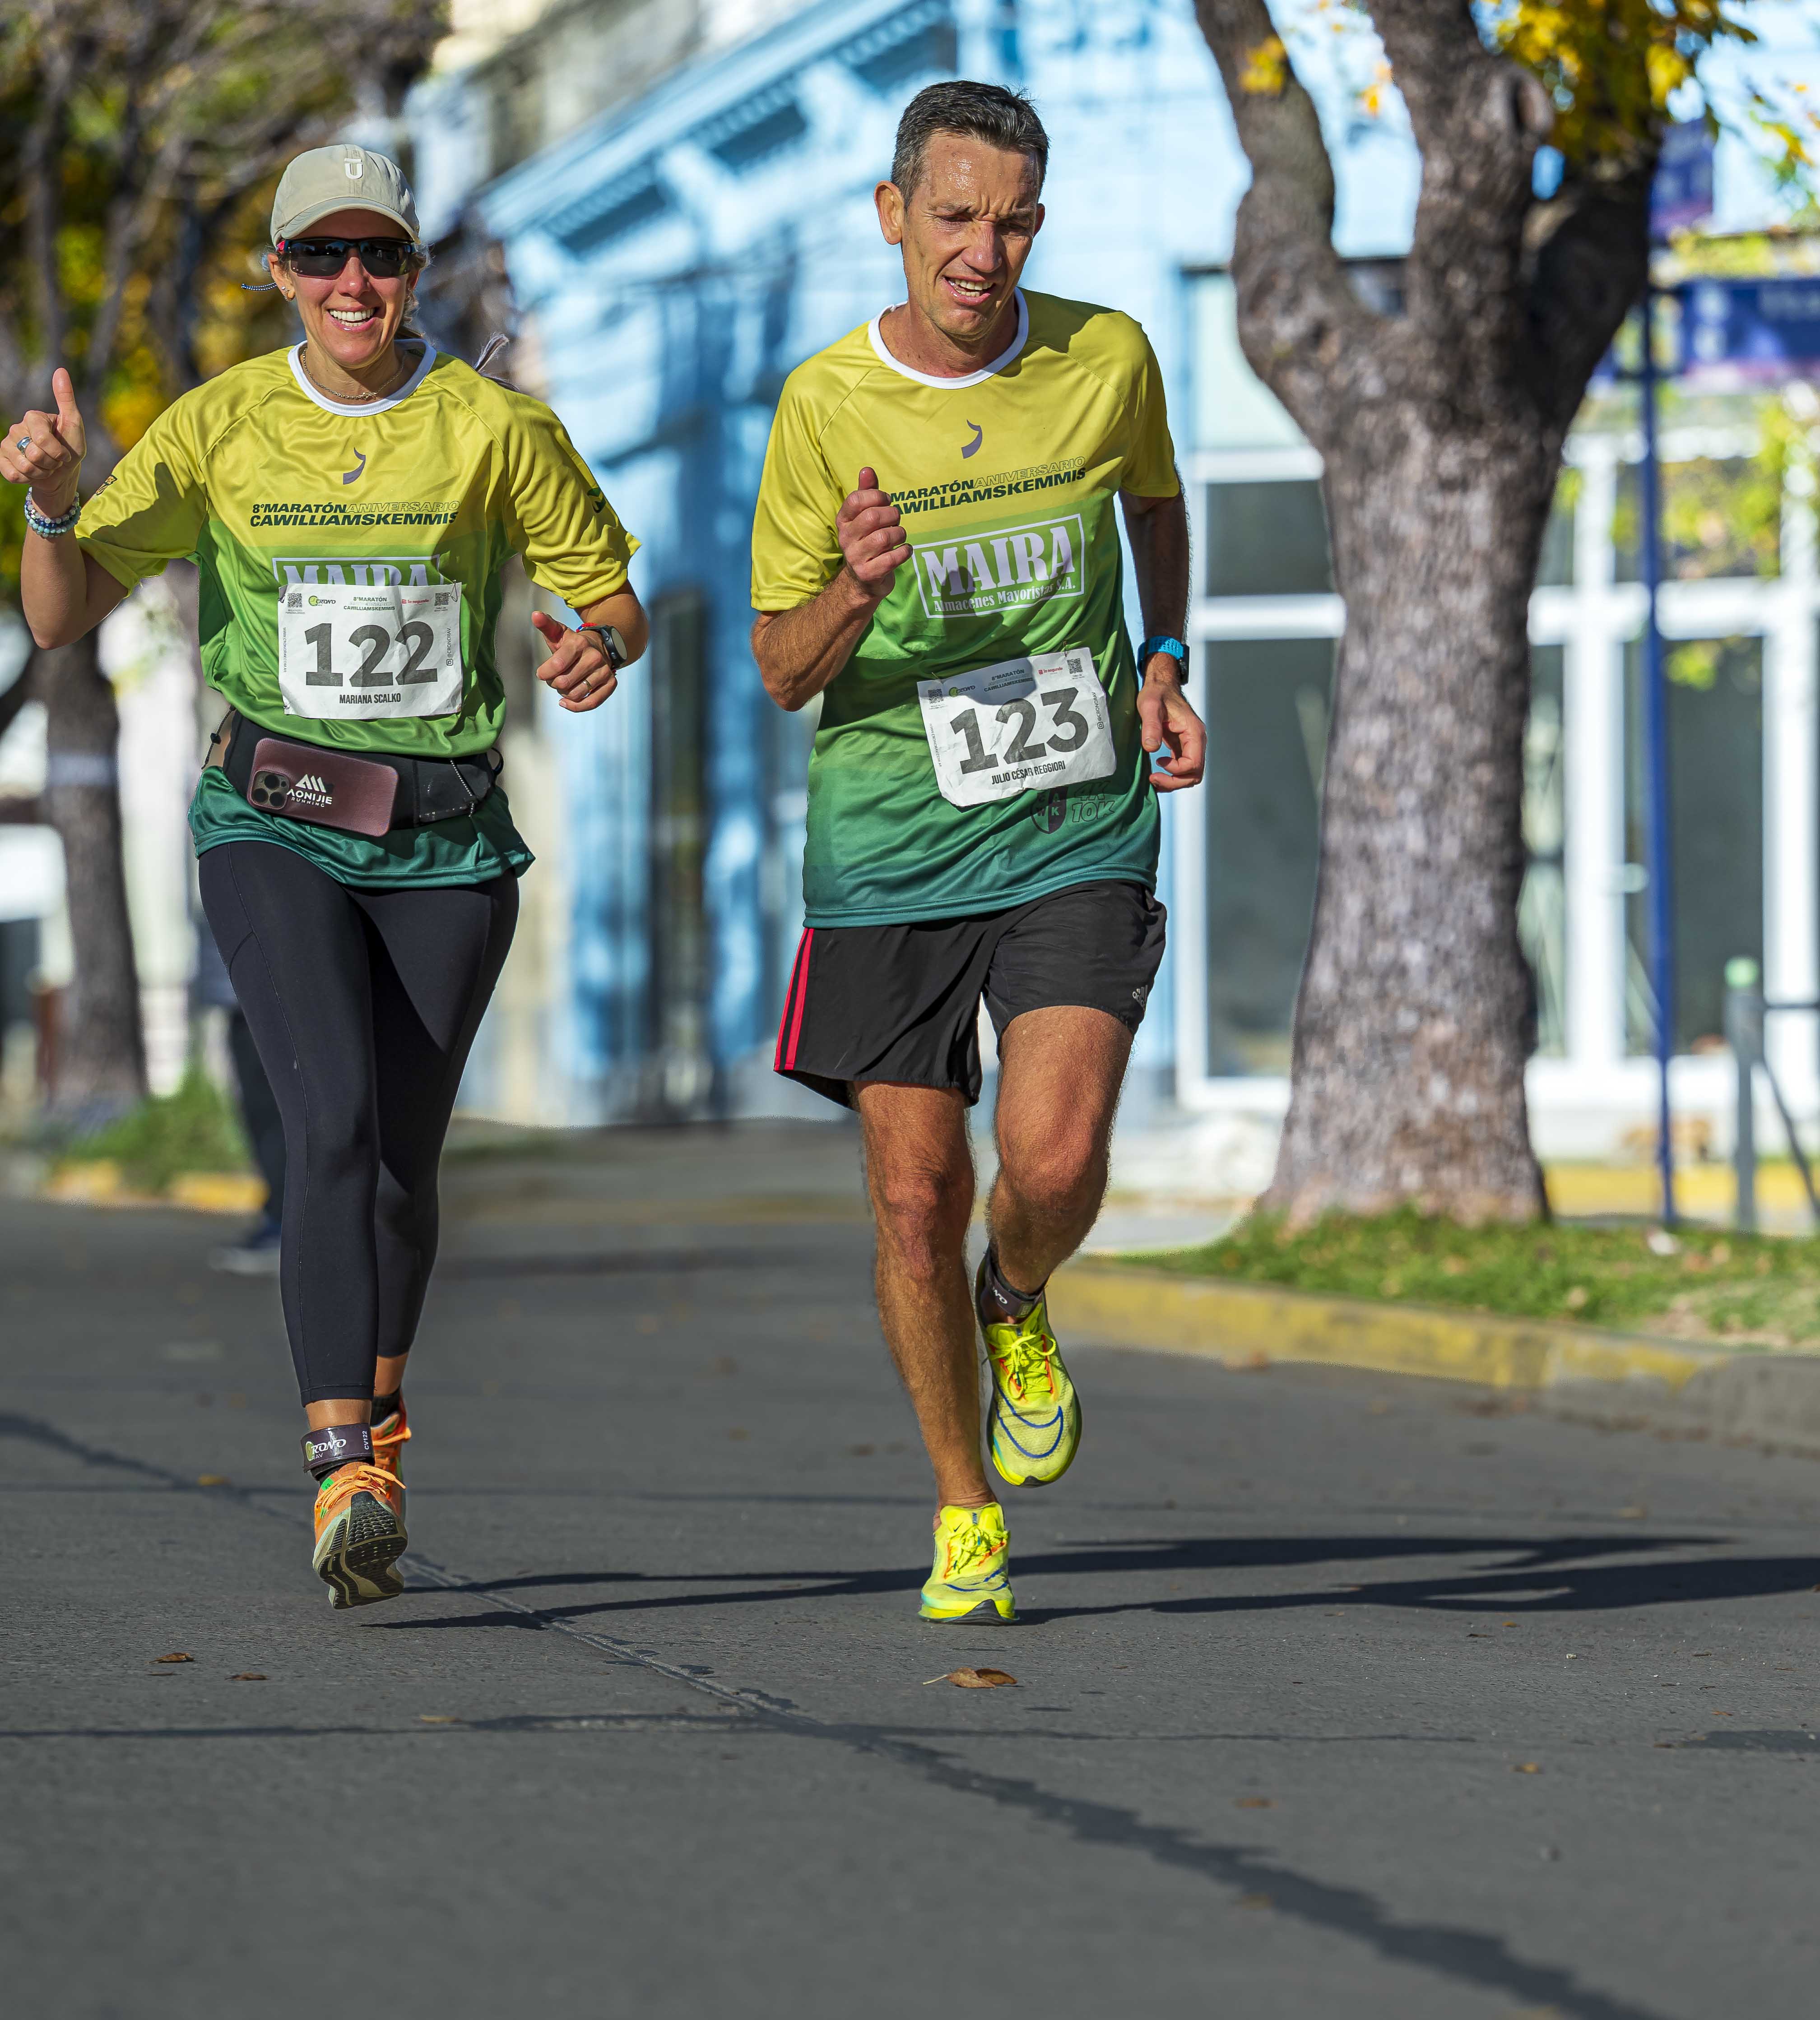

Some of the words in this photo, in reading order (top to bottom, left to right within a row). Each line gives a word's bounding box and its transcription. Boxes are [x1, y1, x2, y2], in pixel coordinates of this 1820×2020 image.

[891, 479, 974, 502] MARATÓN
[893, 468, 1086, 515] AWILLIAMSKEMMIS
[250, 511, 459, 527] CAWILLIAMSKEMMIS
[921, 526, 1076, 597] MAIRA
[933, 594, 995, 612] Almacenes
[997, 582, 1055, 604] Mayoristas
[1056, 578, 1076, 590] S.A.
[304, 621, 438, 687] 122
[984, 677, 1033, 692] CAWILLIAMSKEMMIS
[339, 694, 372, 704] MARIANA
[374, 693, 401, 704] SCALKO
[1091, 692, 1102, 722] @CRONORAV
[949, 686, 1089, 774] 123
[991, 773, 1011, 785] JULIO
[1011, 767, 1033, 780] CÉSAR
[1034, 760, 1066, 775] REGGIORI
[286, 788, 333, 805] AONIJIE
[291, 797, 325, 808] RUNNING
[1072, 801, 1115, 823] 10K
